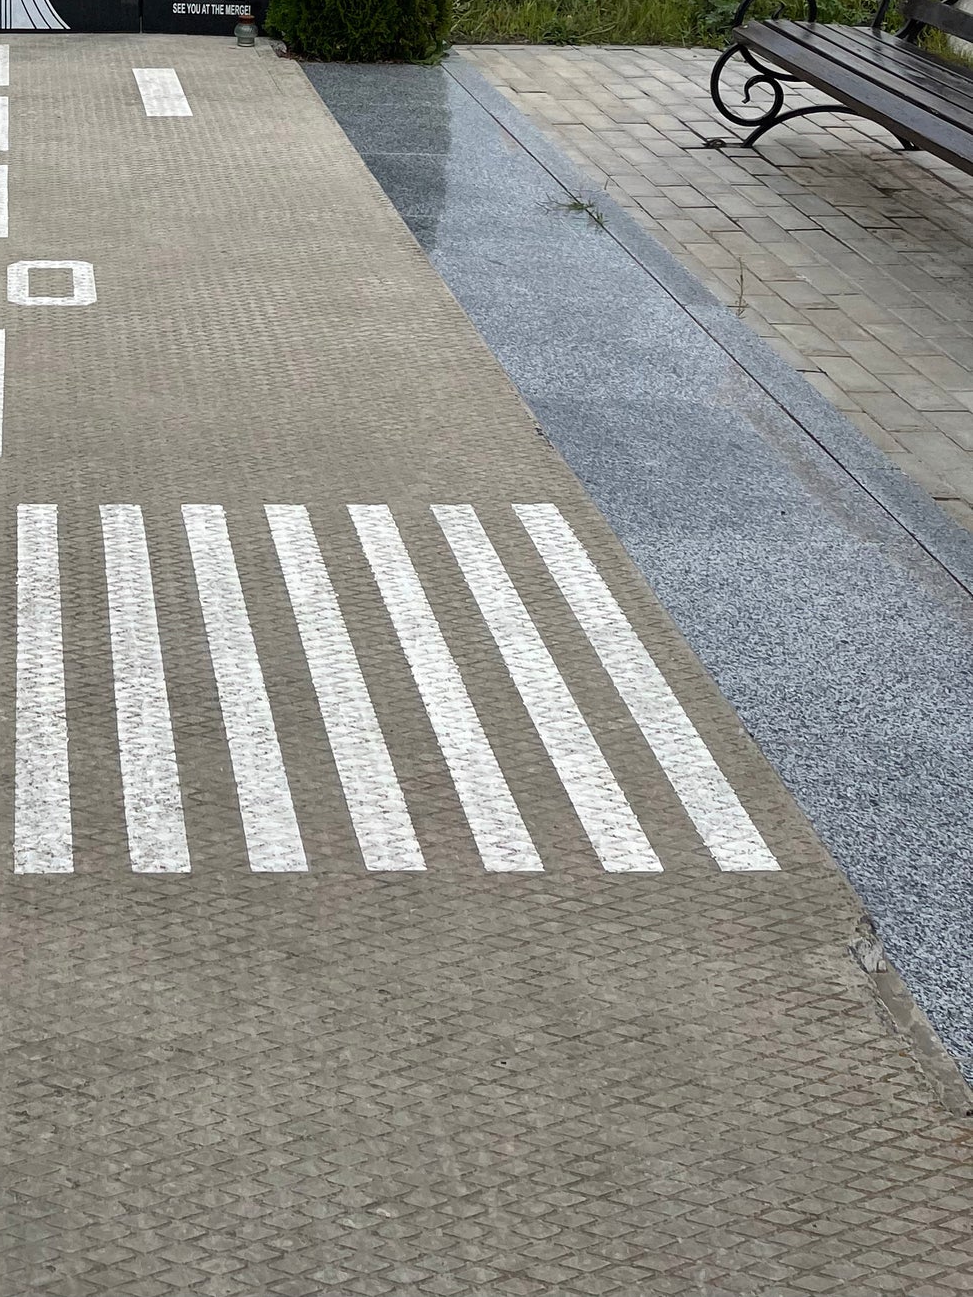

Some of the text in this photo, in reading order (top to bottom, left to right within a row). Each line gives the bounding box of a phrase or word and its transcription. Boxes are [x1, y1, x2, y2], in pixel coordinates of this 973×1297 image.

[172, 3, 251, 15] SEE YOU AT THE MERGE!
